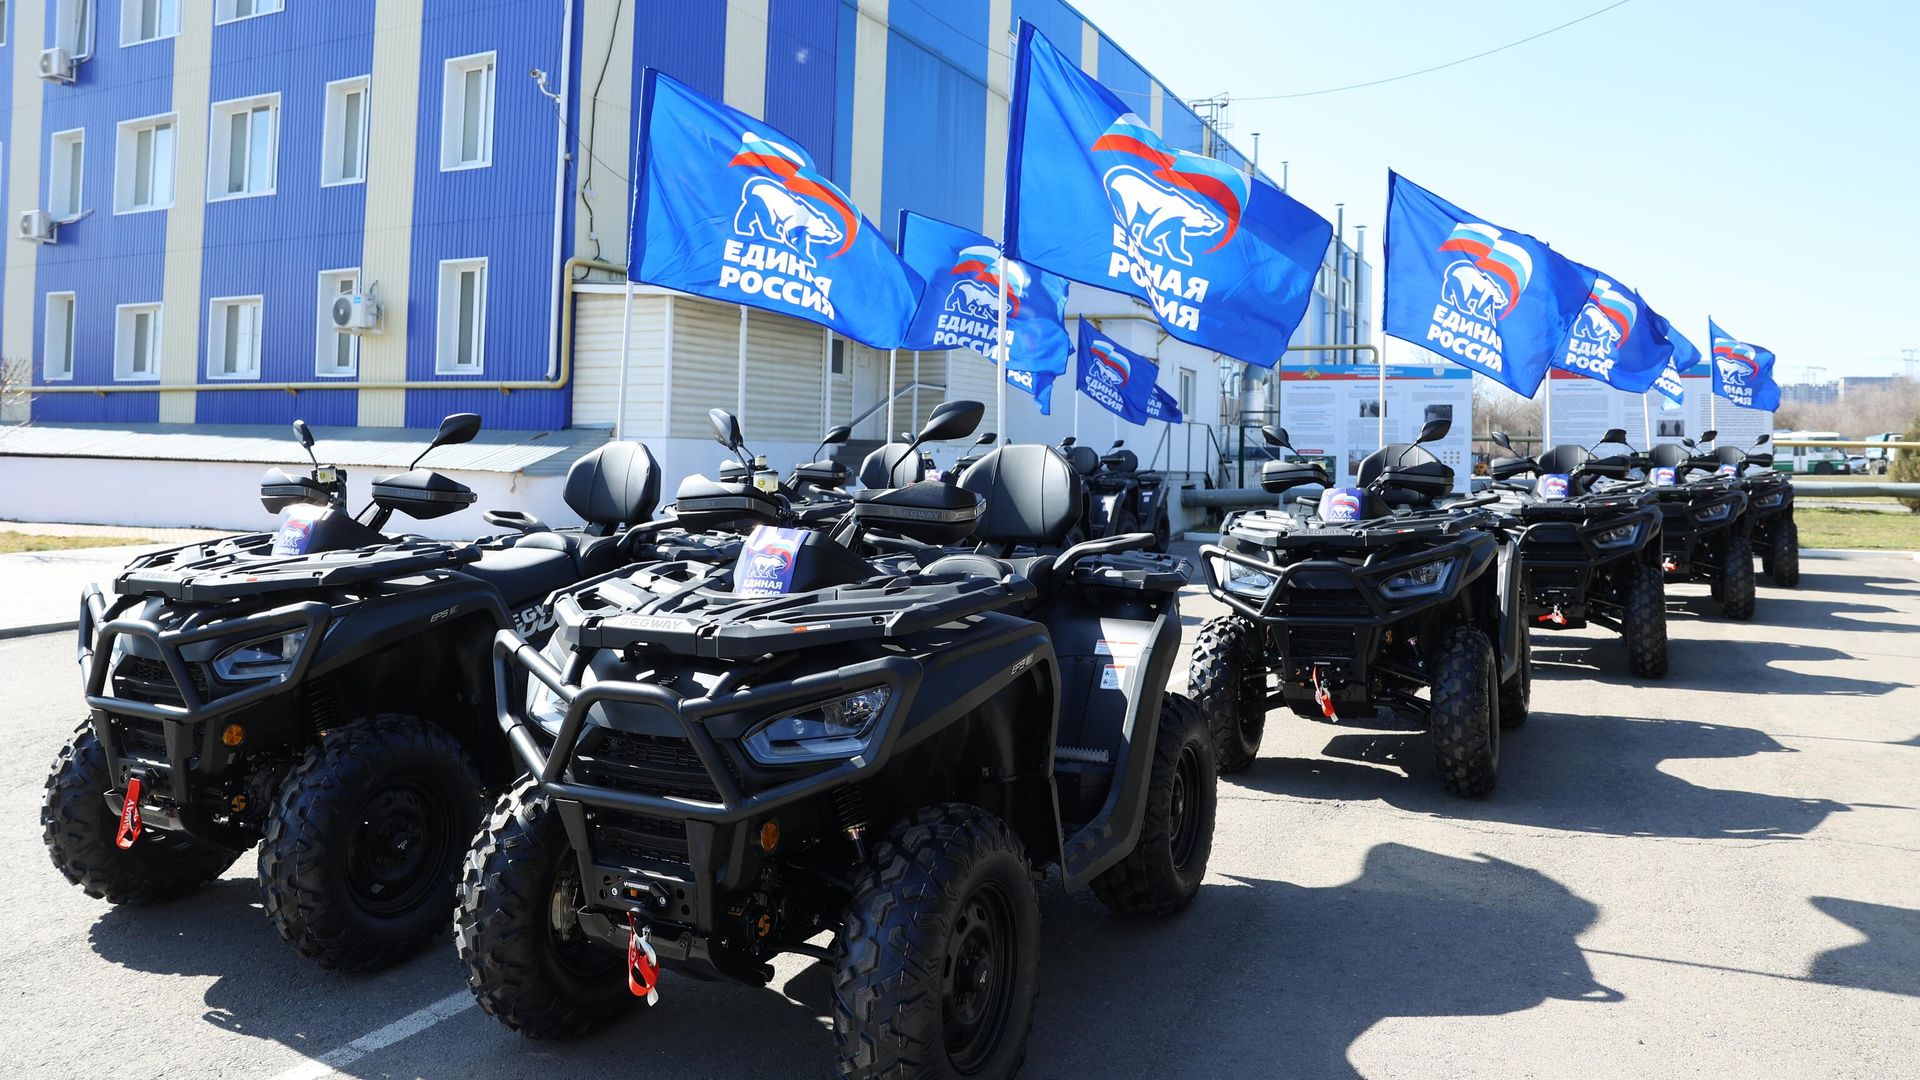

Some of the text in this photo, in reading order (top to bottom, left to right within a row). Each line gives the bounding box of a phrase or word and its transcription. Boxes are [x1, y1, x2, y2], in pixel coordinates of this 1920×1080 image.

[719, 265, 835, 320] РОССИЯ
[1108, 252, 1199, 331] РОИЯ
[1427, 323, 1503, 373] РОССИЯ
[897, 508, 940, 521] SEGWAY
[429, 609, 449, 623] EPS
[618, 616, 682, 630] SEGWAY
